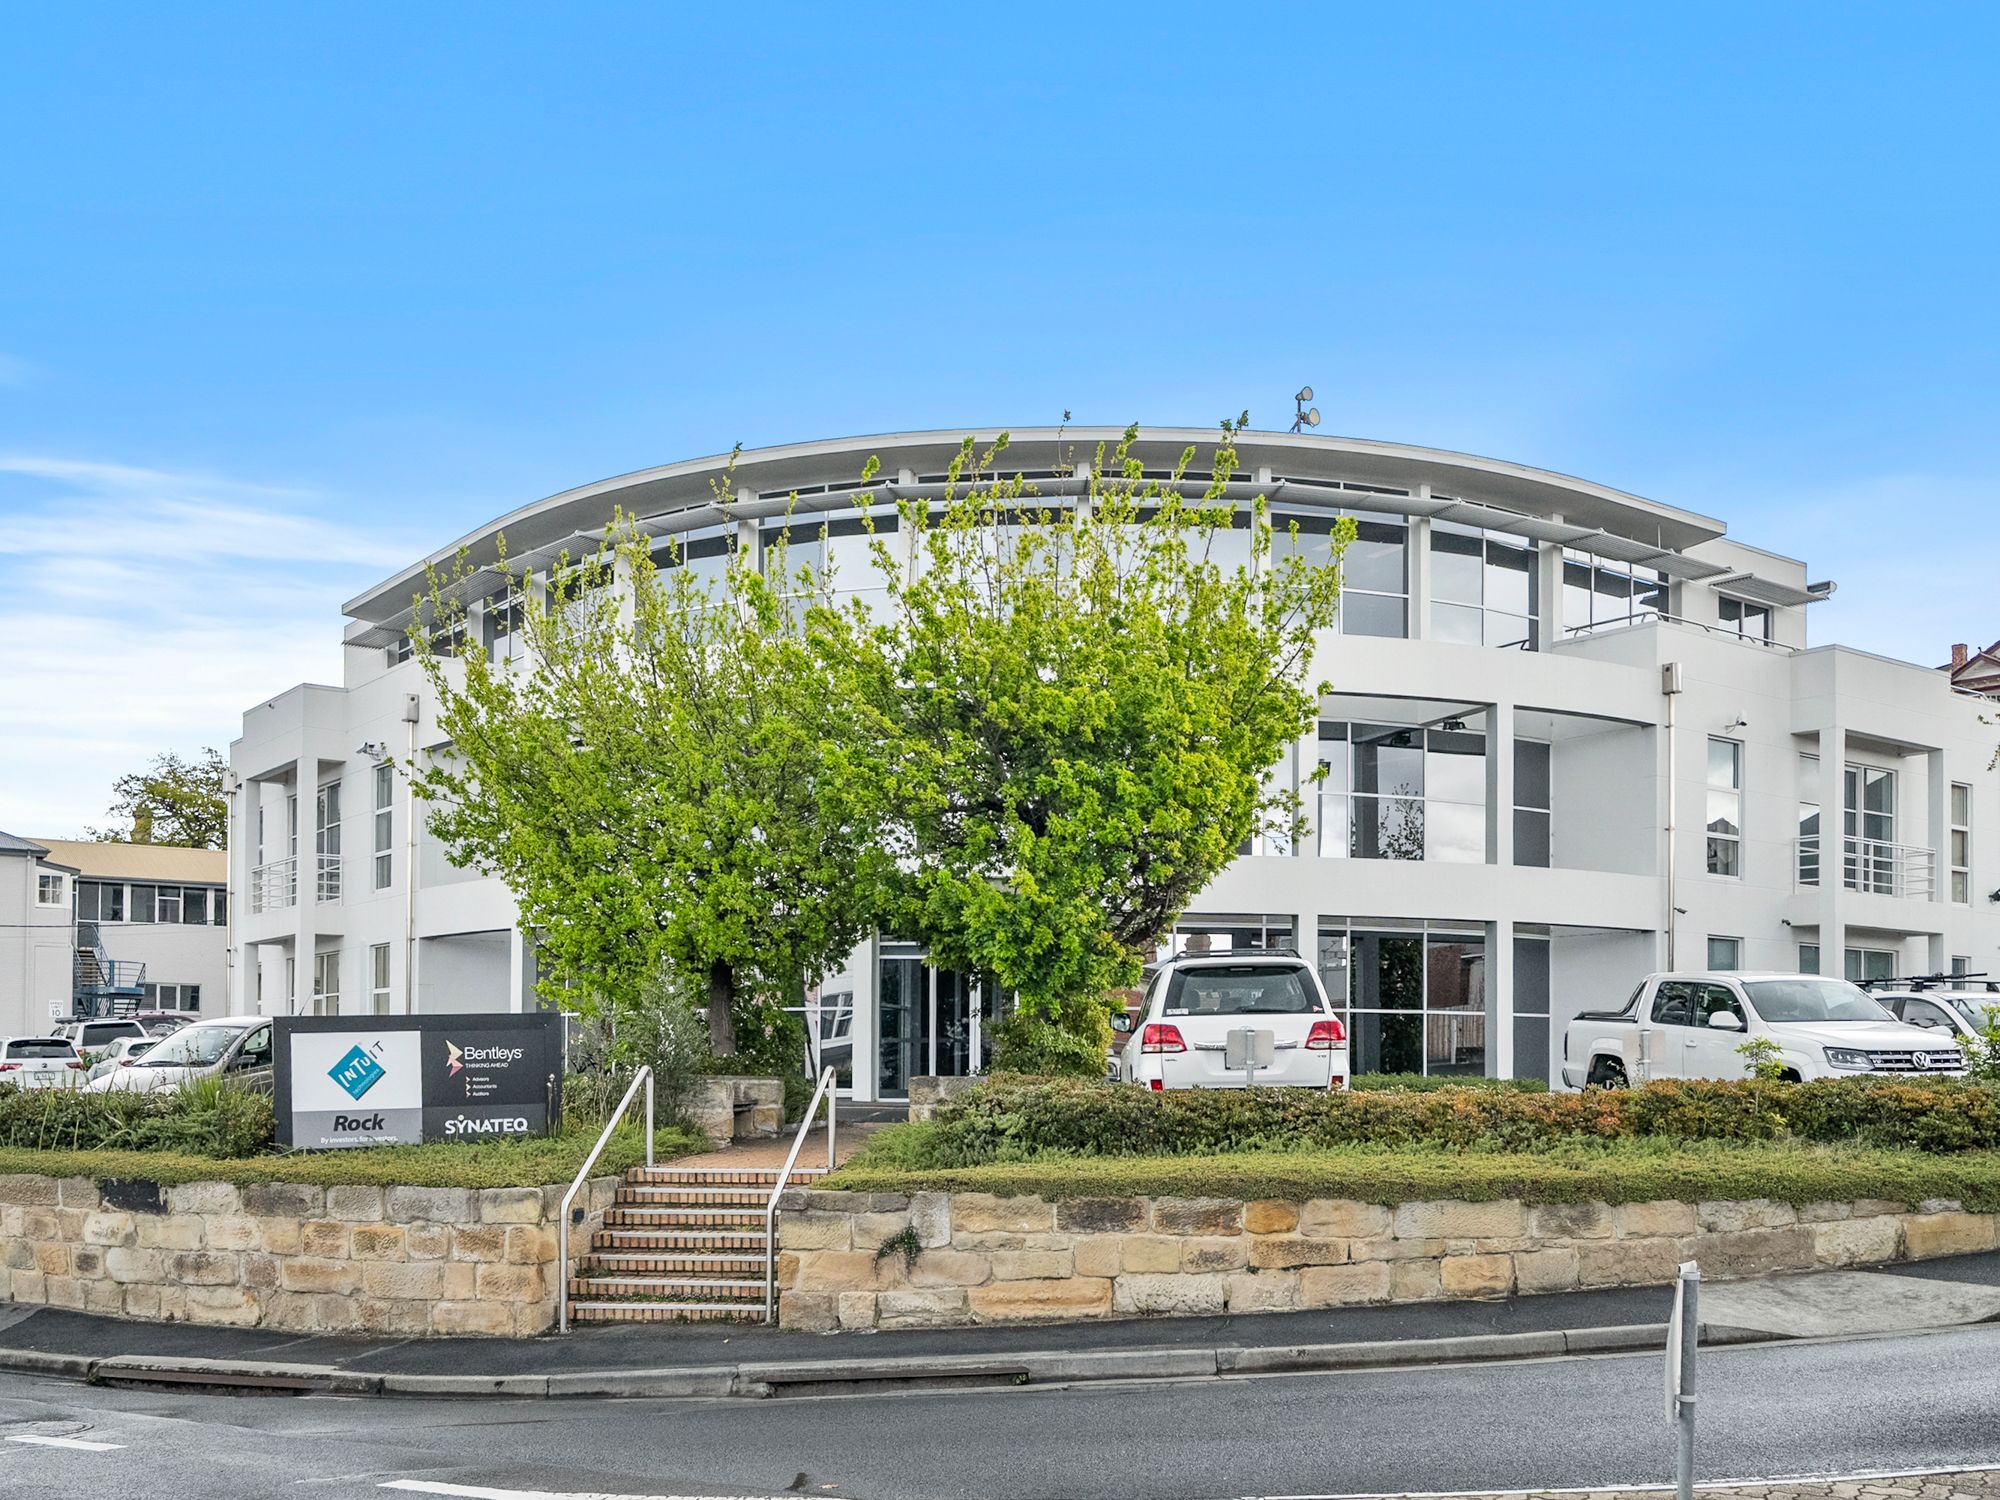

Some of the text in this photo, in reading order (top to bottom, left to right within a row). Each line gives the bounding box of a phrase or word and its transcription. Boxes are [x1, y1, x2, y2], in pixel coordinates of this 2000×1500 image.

[52, 1009, 61, 1017] 10
[464, 1046, 522, 1062] Bentleys
[333, 1113, 385, 1132] Rock
[445, 1117, 529, 1135] SYNATEQ
[320, 1137, 329, 1145] By
